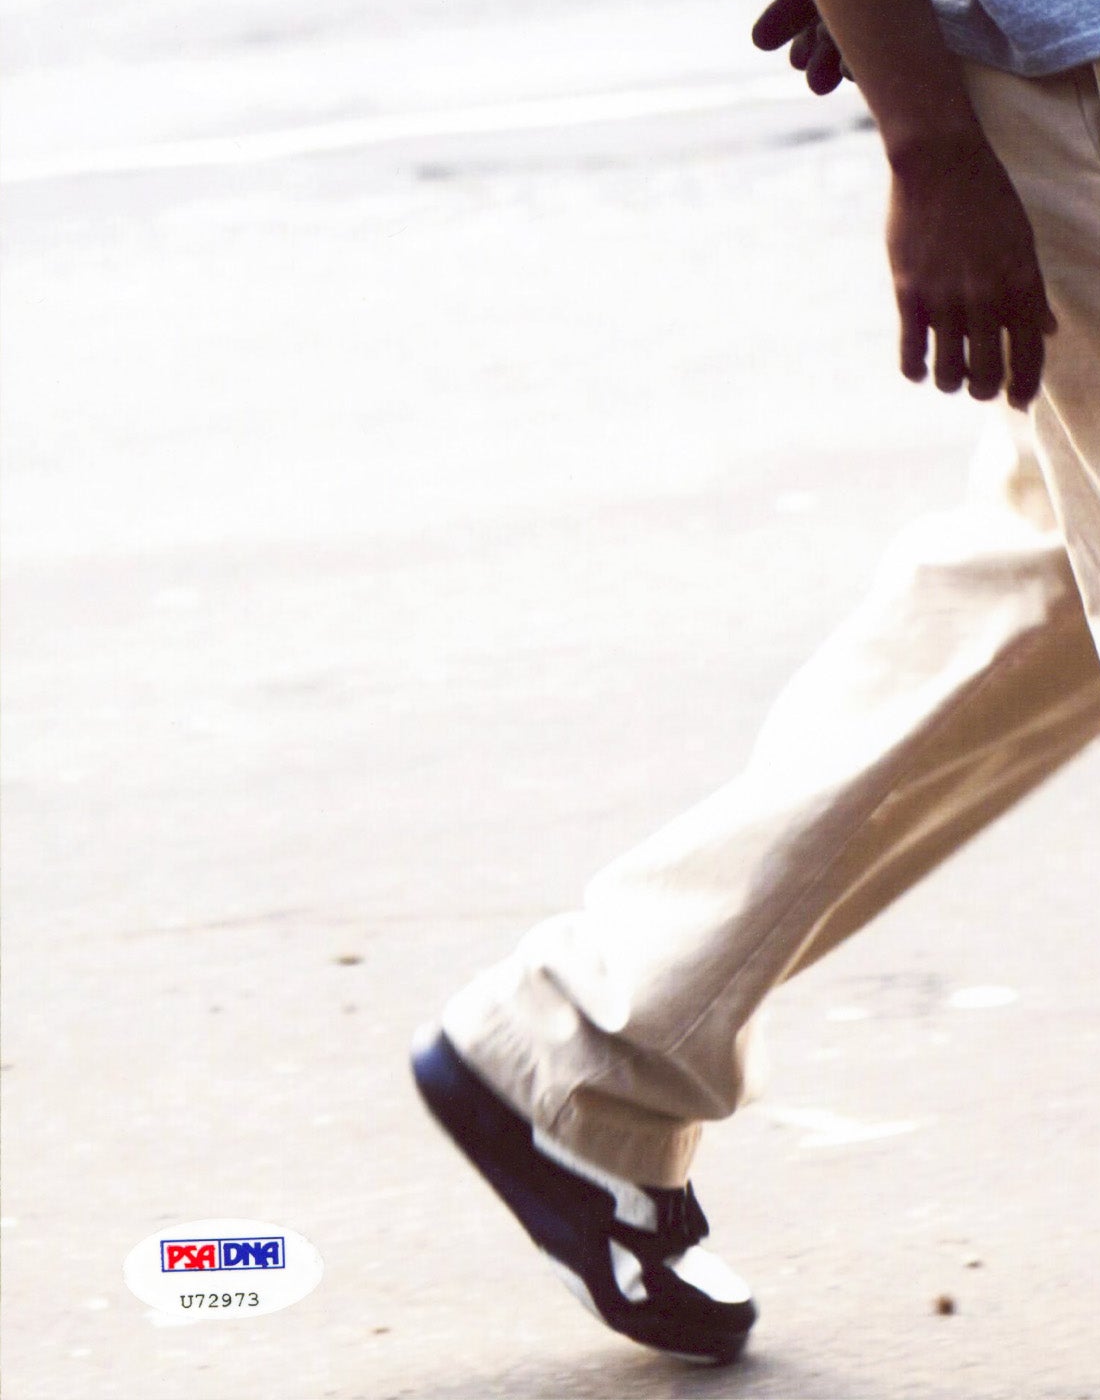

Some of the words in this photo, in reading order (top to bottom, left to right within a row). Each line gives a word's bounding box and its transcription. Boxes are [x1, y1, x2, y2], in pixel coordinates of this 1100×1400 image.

[167, 1244, 216, 1270] PSA
[223, 1241, 279, 1268] DNA
[179, 1292, 260, 1309] U72973
